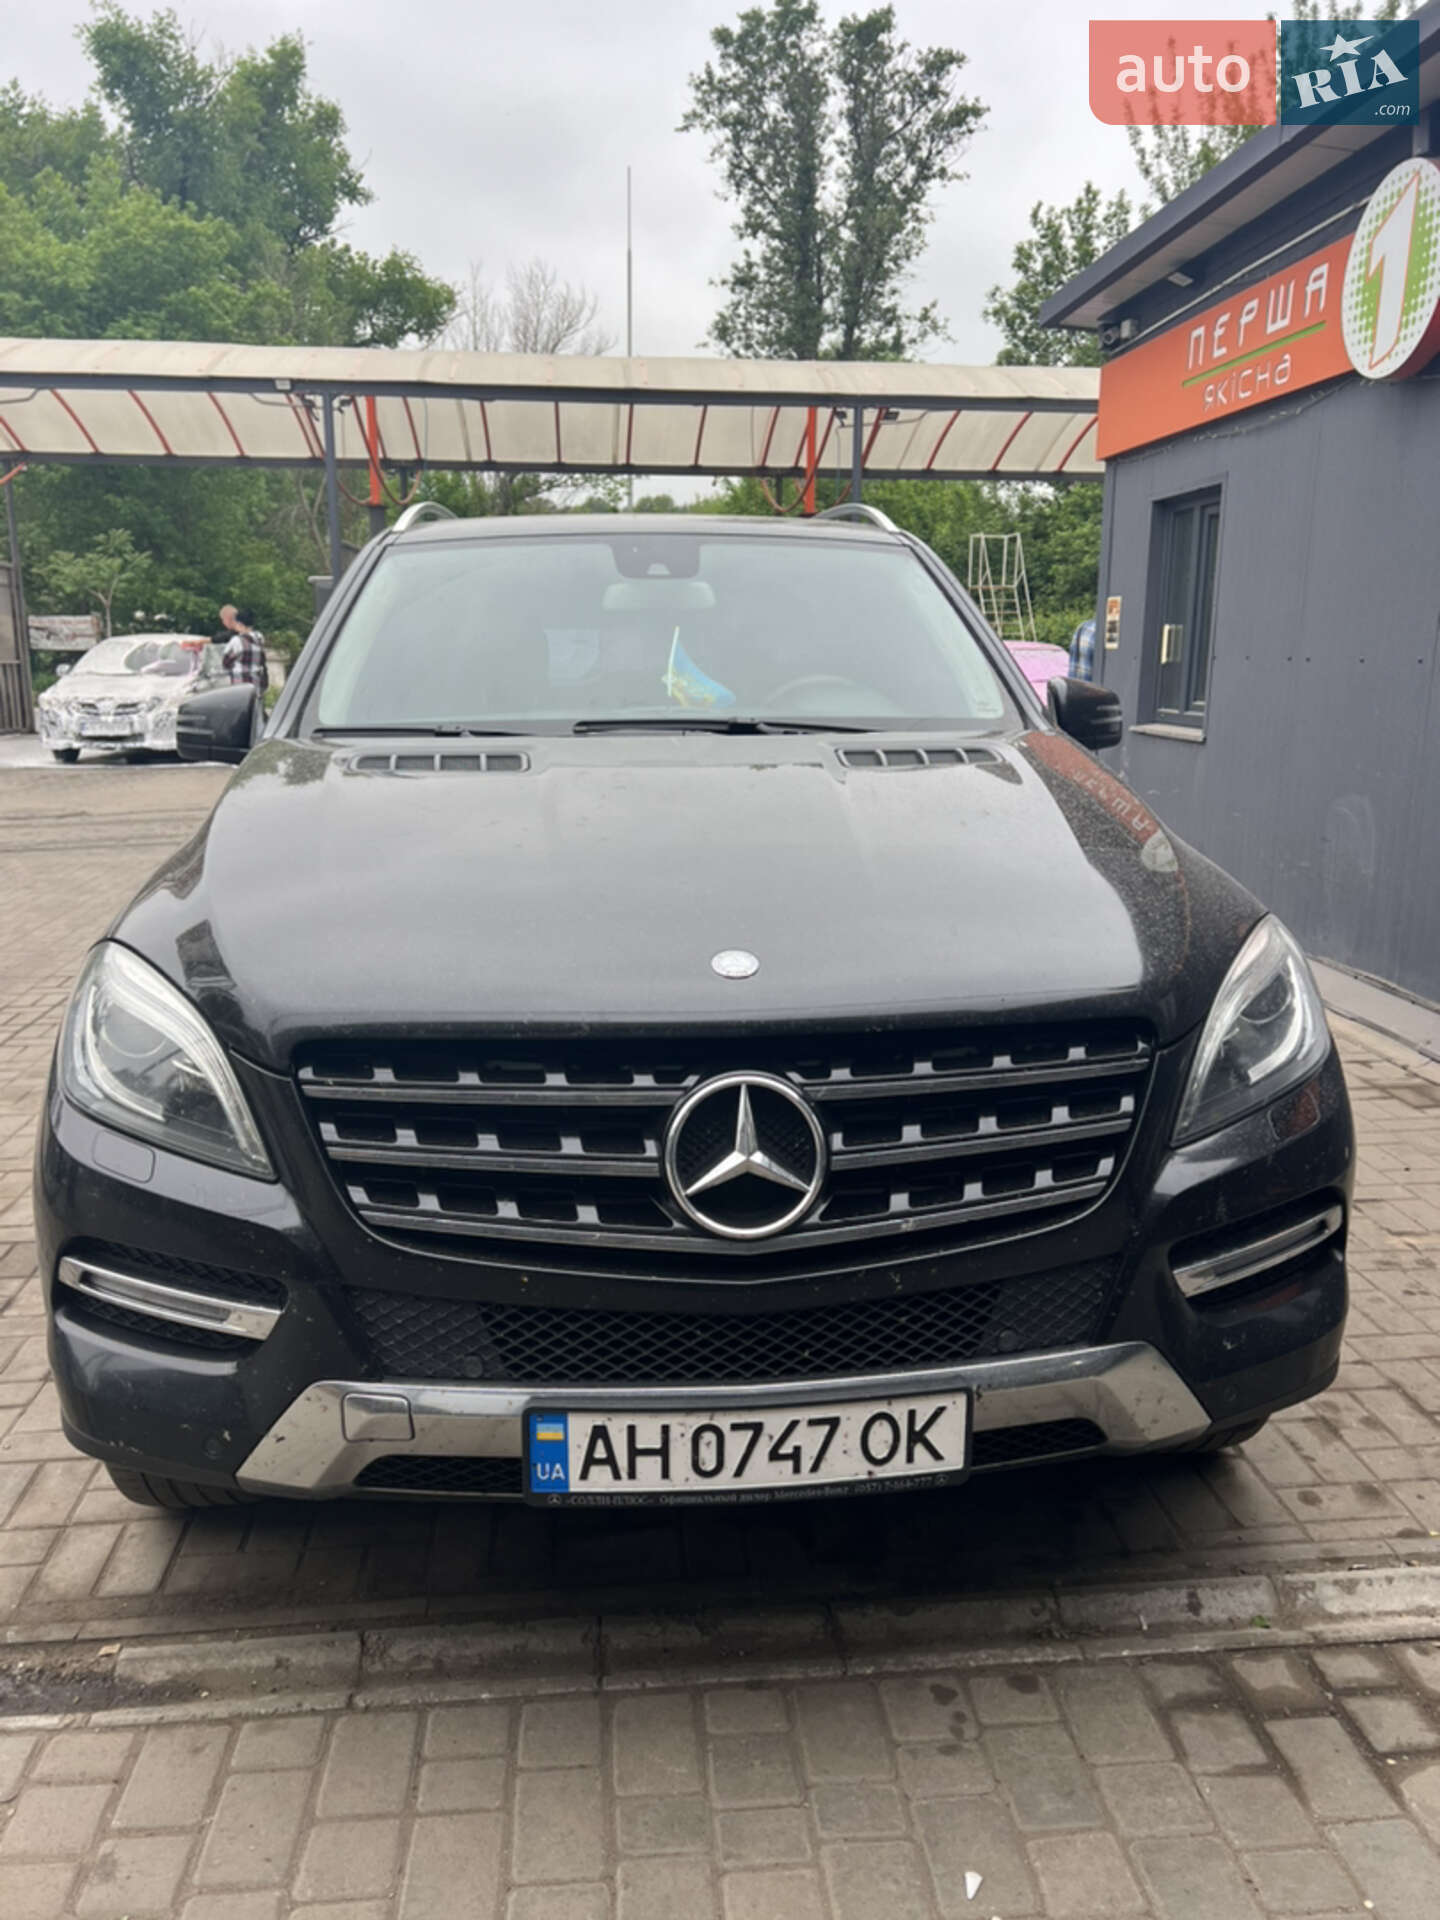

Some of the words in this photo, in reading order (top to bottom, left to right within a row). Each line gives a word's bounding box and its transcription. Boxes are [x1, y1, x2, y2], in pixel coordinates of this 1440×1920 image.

[1187, 261, 1330, 370] ПЕРША
[536, 1463, 566, 1481] UA
[578, 1423, 671, 1481] AH
[690, 1416, 841, 1479] 0747
[859, 1405, 948, 1467] OK
